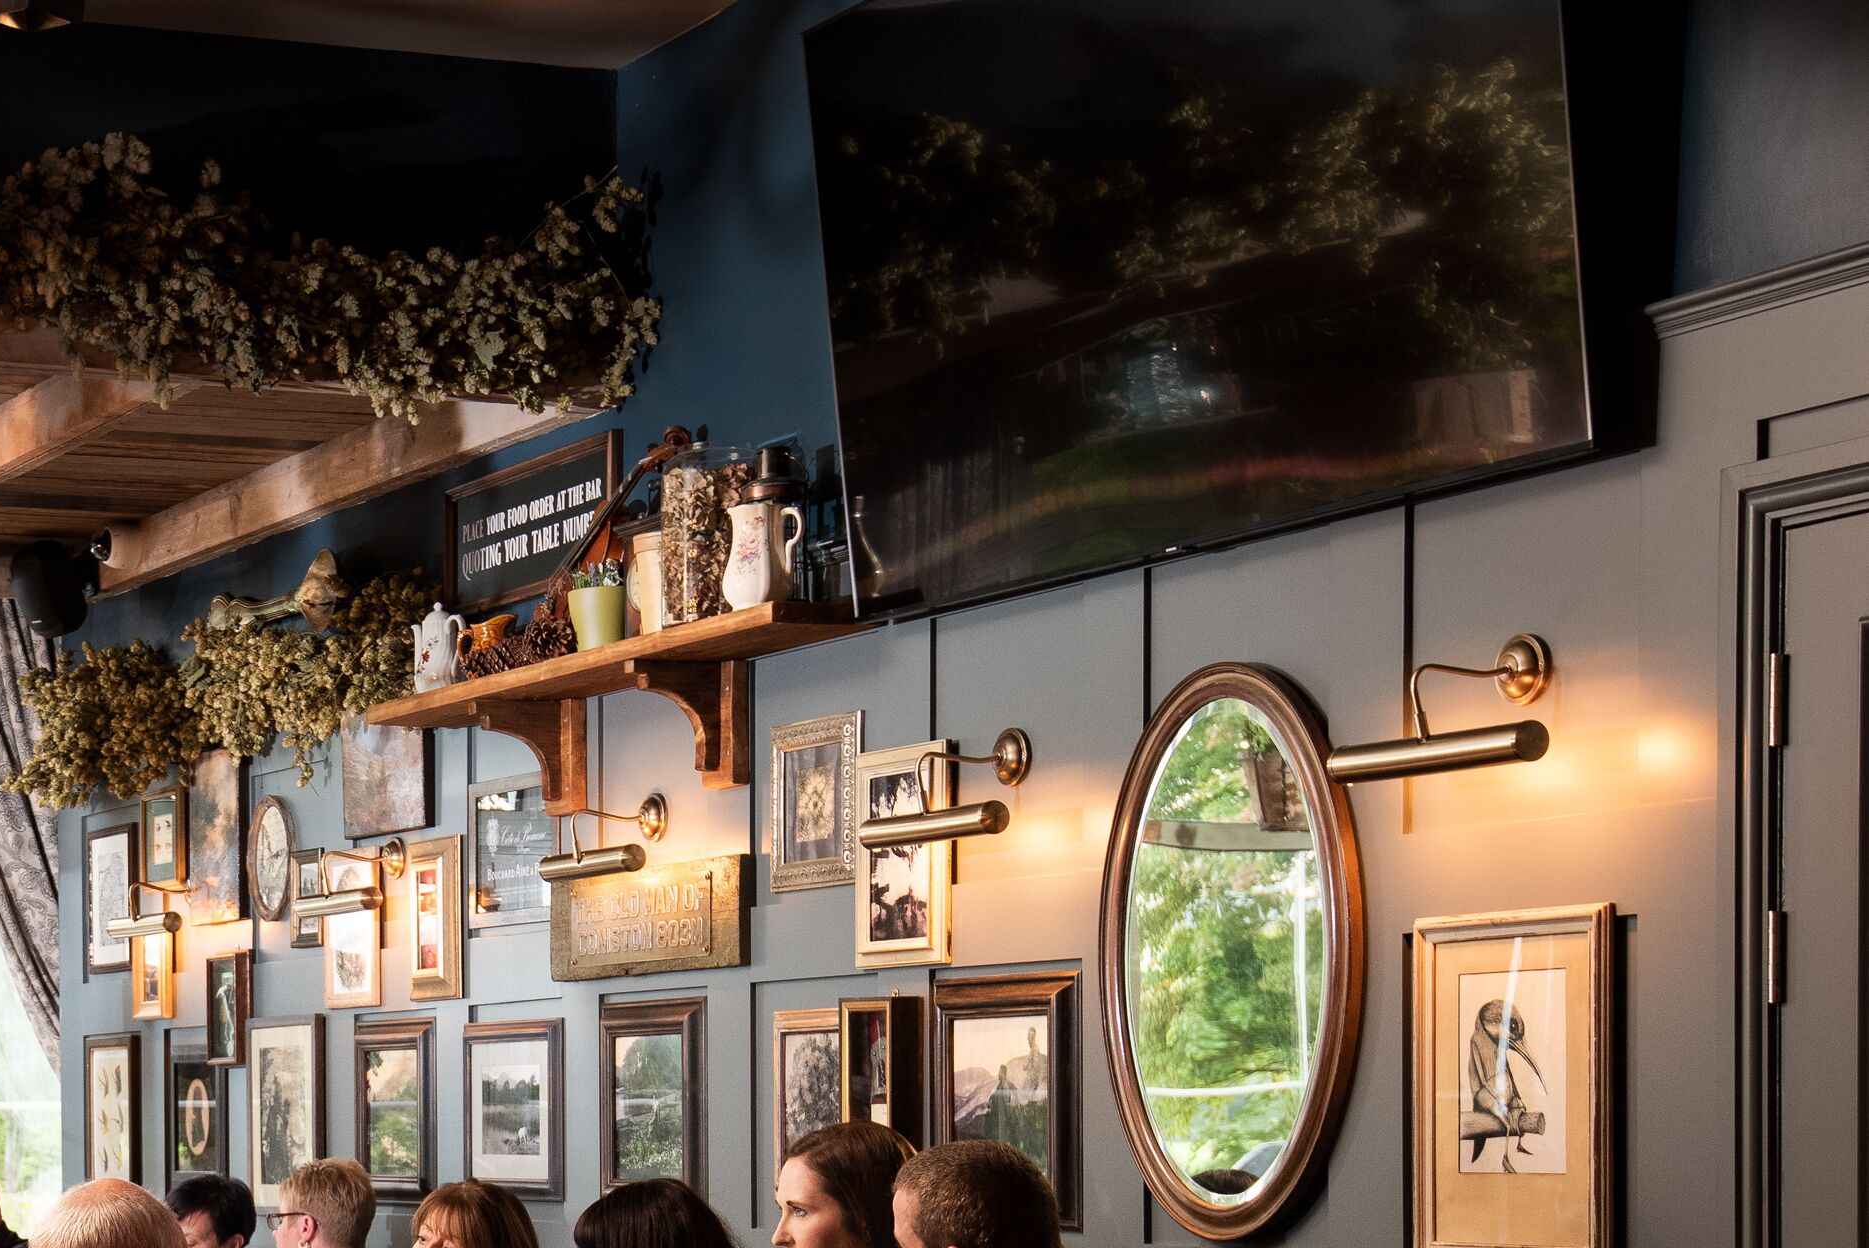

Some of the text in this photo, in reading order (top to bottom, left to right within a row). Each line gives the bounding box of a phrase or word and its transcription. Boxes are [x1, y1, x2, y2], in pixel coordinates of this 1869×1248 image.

[462, 477, 602, 544] PLACE YOUR FOOD ORDER AT THE BAR
[462, 542, 501, 581] QUOTING
[504, 534, 529, 563] YOUR
[531, 522, 560, 554] TABLE
[576, 883, 707, 925] THE OLD MAN OF
[578, 921, 653, 957] CONISTON
